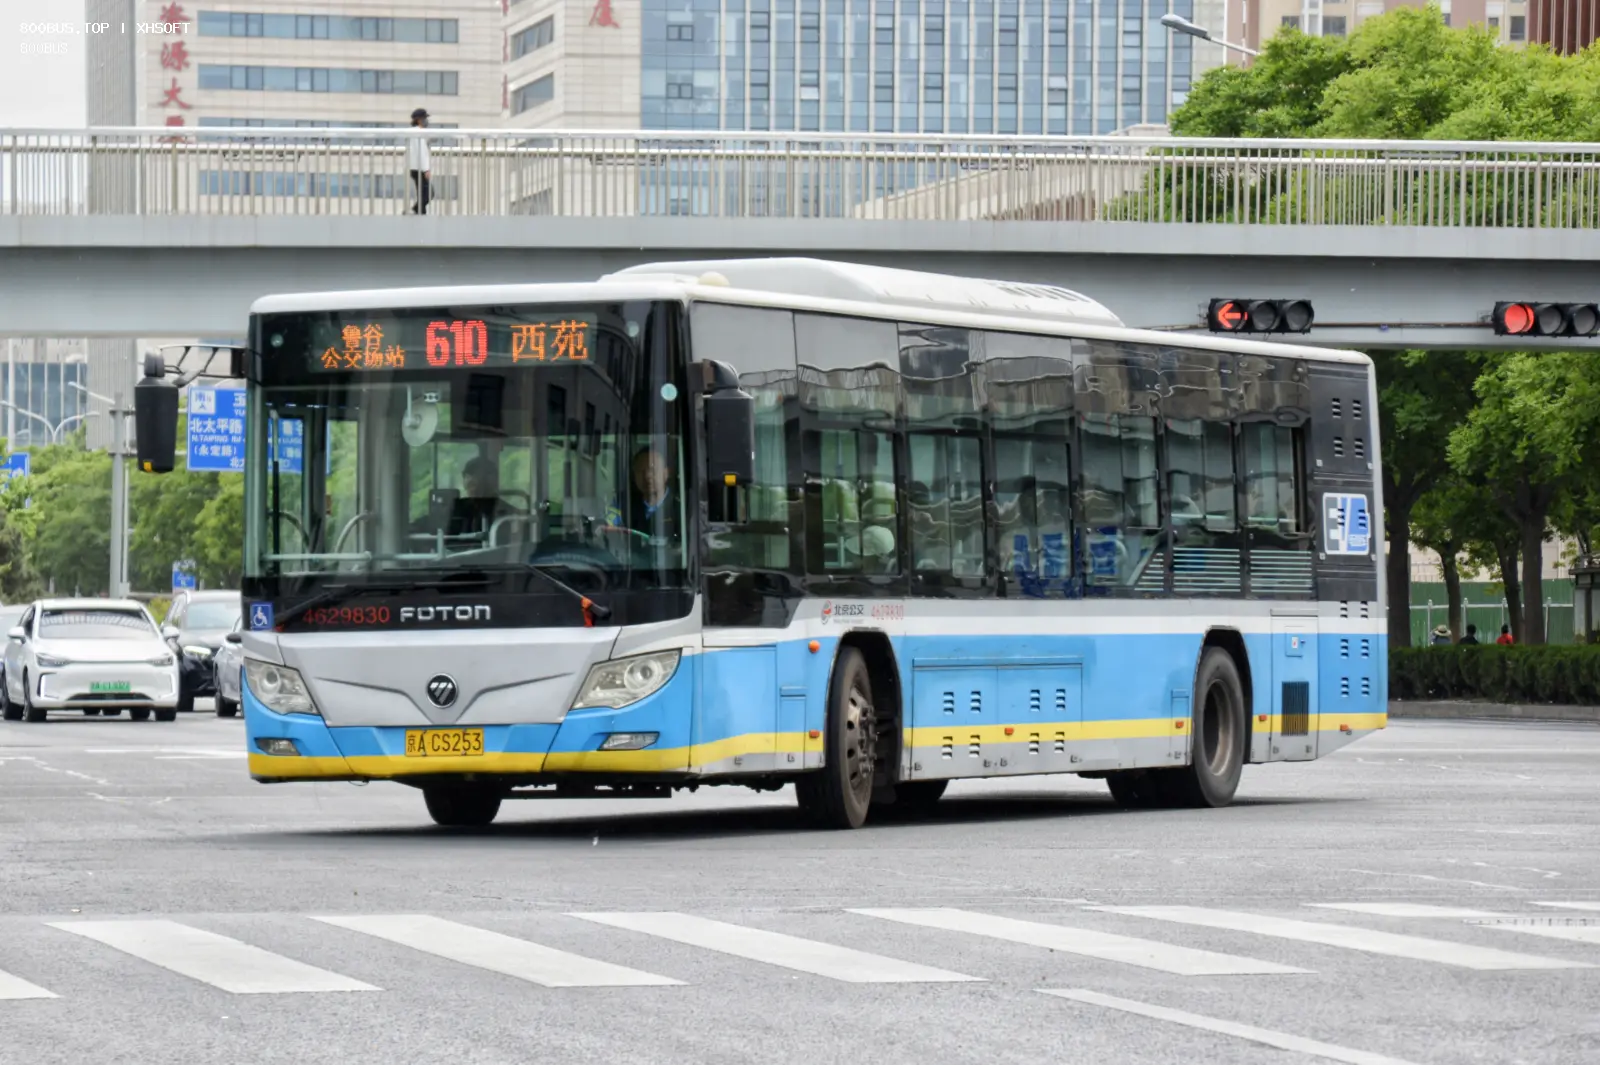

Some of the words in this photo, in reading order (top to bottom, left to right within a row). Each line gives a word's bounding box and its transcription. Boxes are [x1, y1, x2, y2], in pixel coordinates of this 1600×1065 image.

[426, 320, 488, 366] 610
[510, 319, 589, 363] 西苑
[320, 344, 406, 369] 公交场站
[303, 606, 390, 625] 4629830
[400, 605, 491, 622] FOTON
[834, 604, 864, 616] 北京公交
